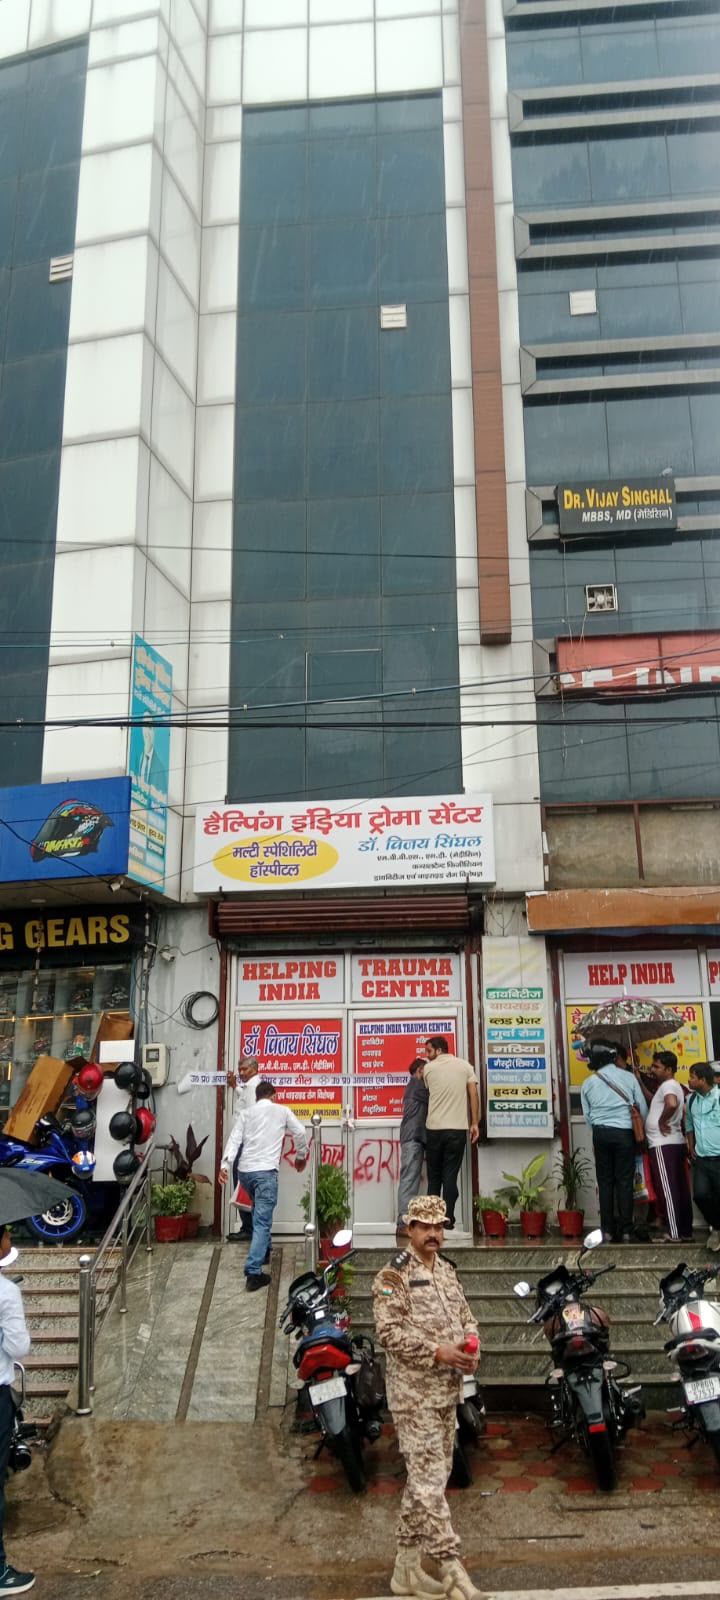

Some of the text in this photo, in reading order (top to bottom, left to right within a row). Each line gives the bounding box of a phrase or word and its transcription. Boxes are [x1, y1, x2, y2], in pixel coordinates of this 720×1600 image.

[586, 488, 619, 508] VIJAY
[621, 485, 673, 507] SINGHAL
[582, 510, 613, 523] MBBS,
[616, 509, 631, 520] MD
[203, 810, 284, 835] हैल्पिंग
[368, 805, 421, 834] ट्रोमा
[429, 802, 484, 825] सेंटर
[232, 841, 260, 859] मल्टी
[358, 833, 483, 852] डॉ. विजय सिंघल
[249, 860, 300, 879] हॉस्पीटल
[25, 914, 130, 949] GEARS
[242, 960, 337, 981] HELPING
[358, 958, 453, 976] TRAUMA
[587, 962, 675, 986] HELP INDIA
[258, 982, 321, 1001] INDIA
[361, 979, 450, 998] CENTRE
[359, 1021, 452, 1035] HELPING INDIA TRAUMA CENTRE
[489, 1015, 542, 1025] ब्लड प्रेशर
[242, 1024, 340, 1056] डॉ. विजय सिंघल
[521, 1086, 542, 1095] रोग
[493, 1101, 542, 1110] लकवा
